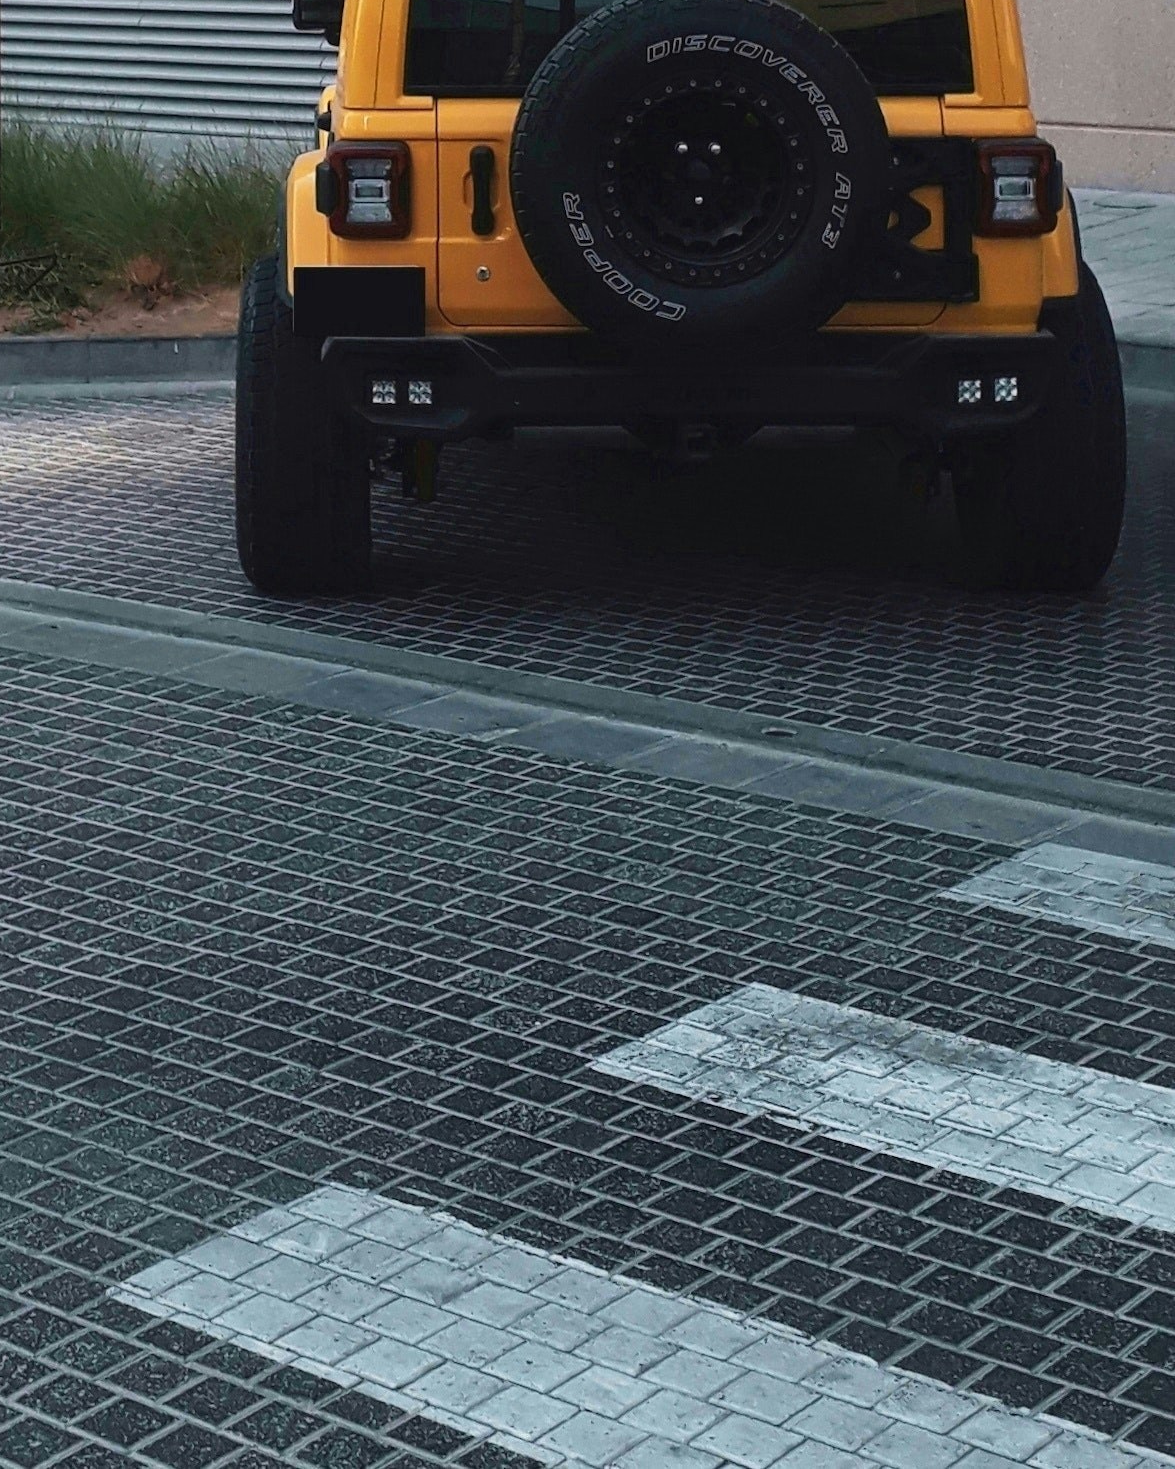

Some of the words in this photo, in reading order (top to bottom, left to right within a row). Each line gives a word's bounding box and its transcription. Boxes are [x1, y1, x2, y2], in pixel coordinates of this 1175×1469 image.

[646, 34, 848, 154] DISCOVERER
[822, 172, 851, 249] AT3
[563, 192, 686, 321] COOPER
